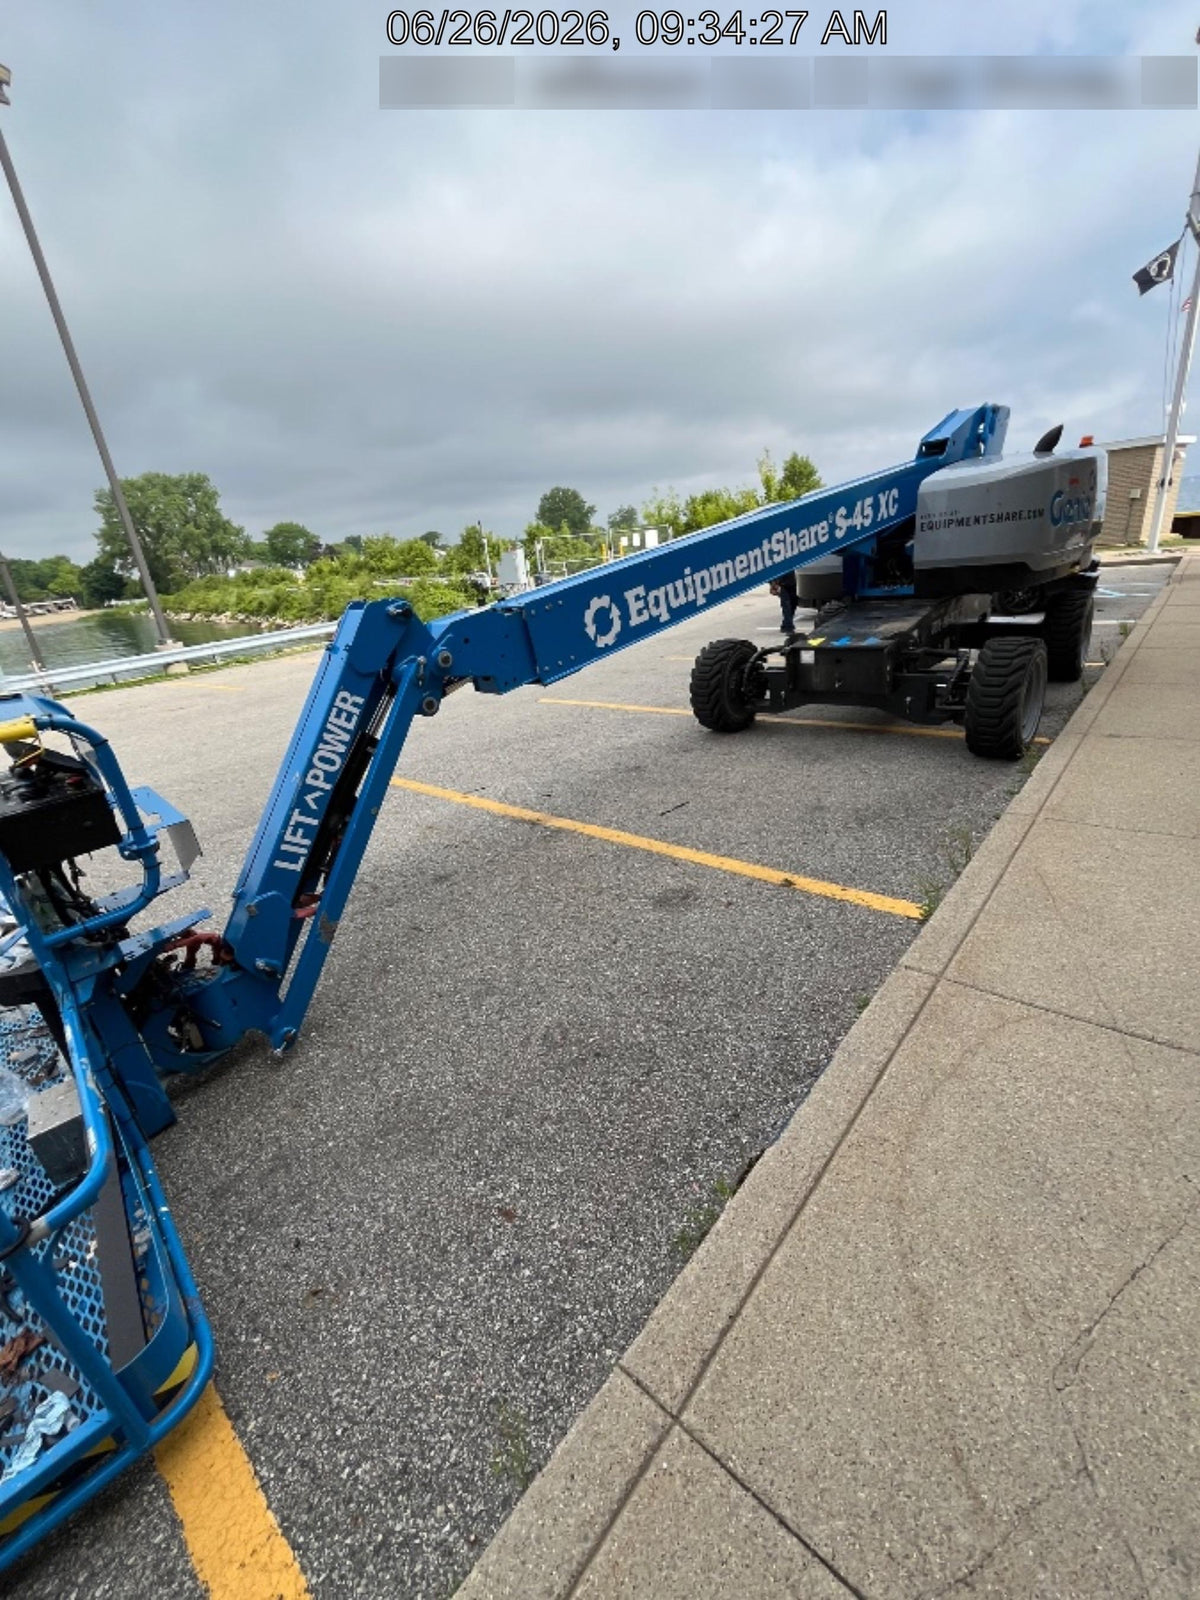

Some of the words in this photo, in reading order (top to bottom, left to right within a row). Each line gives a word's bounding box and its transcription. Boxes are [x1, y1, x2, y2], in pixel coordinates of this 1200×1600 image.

[623, 520, 830, 626] EquipmentShare
[834, 496, 875, 539] S-45
[876, 488, 900, 522] XC
[920, 508, 1045, 532] EQUIPMENTSHARE.COM
[273, 808, 320, 872] LIFT
[304, 690, 366, 790] POWER
